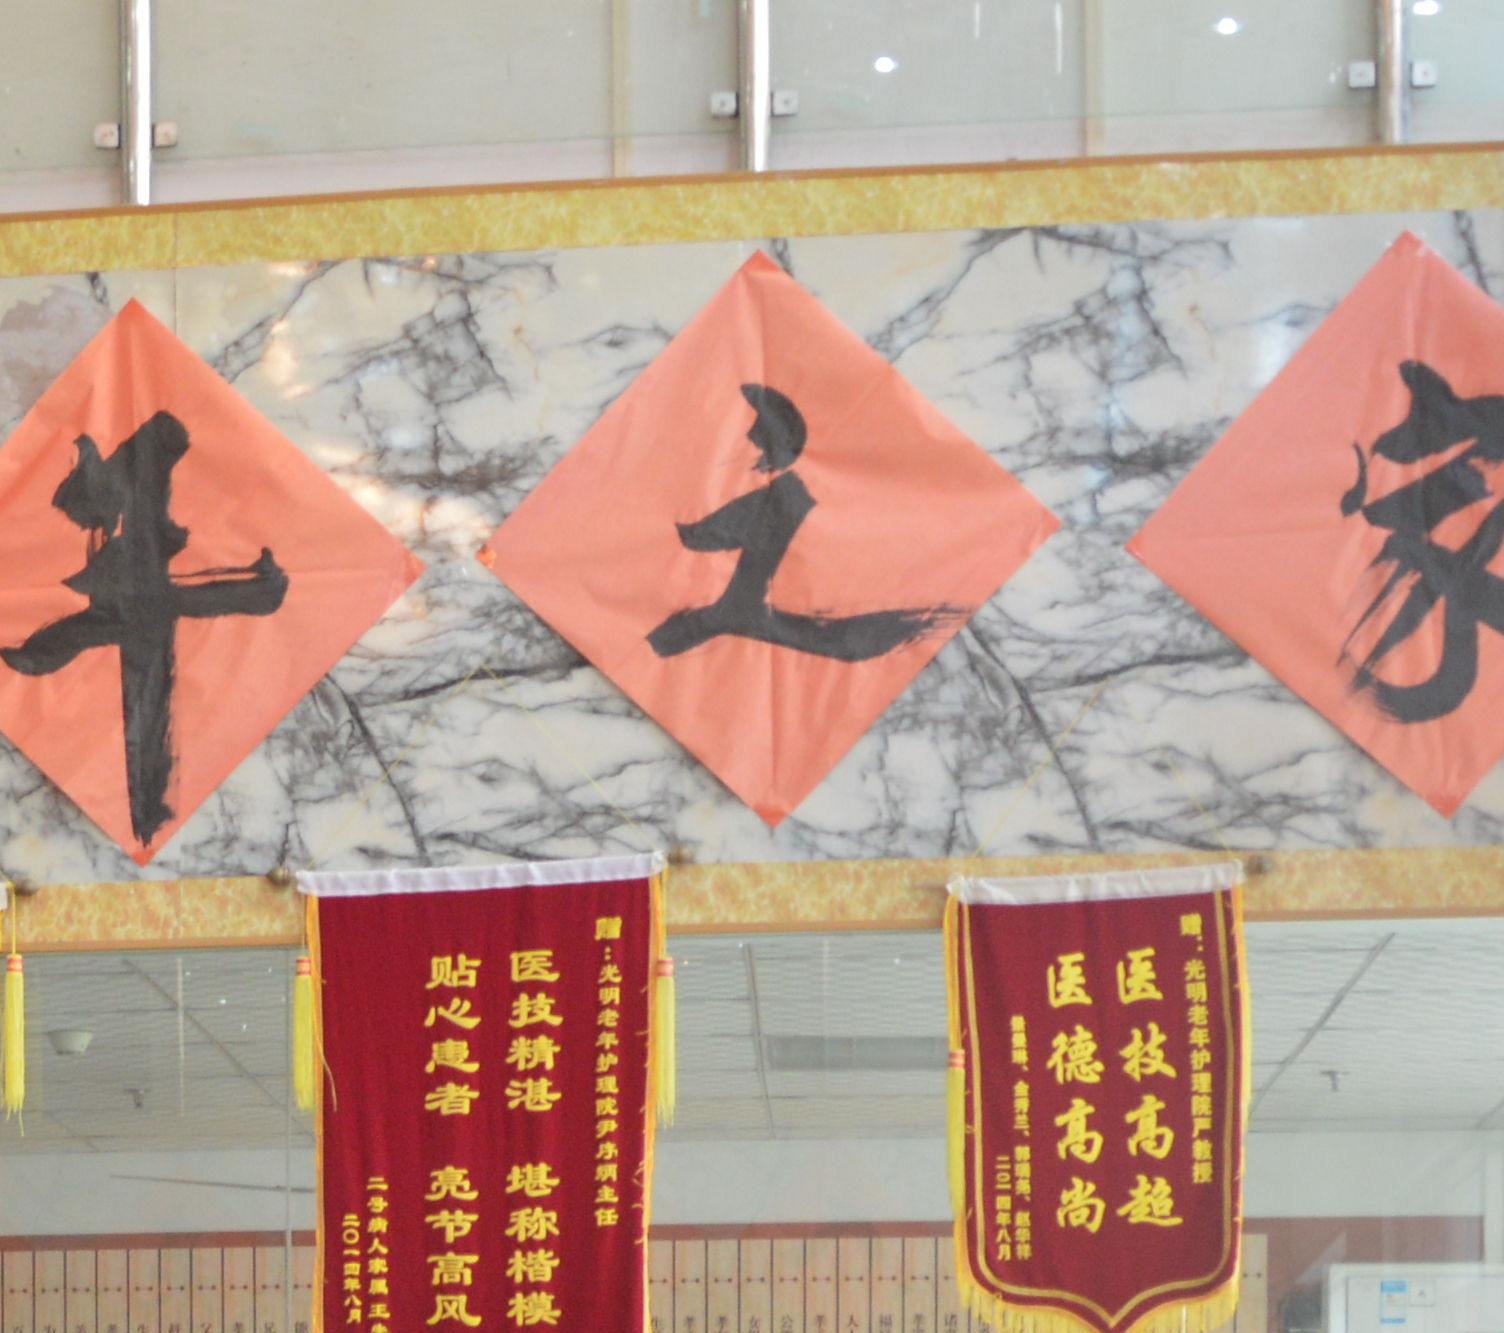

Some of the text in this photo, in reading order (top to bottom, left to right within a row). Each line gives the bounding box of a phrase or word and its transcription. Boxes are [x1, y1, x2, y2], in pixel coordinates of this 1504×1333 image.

[422, 952, 484, 1329] 贴心患者 亮节高风
[502, 948, 565, 1328] 医技精湛 堪称楷模
[1045, 951, 1107, 1234] 医德高尚
[1114, 946, 1185, 1228] 医技高超
